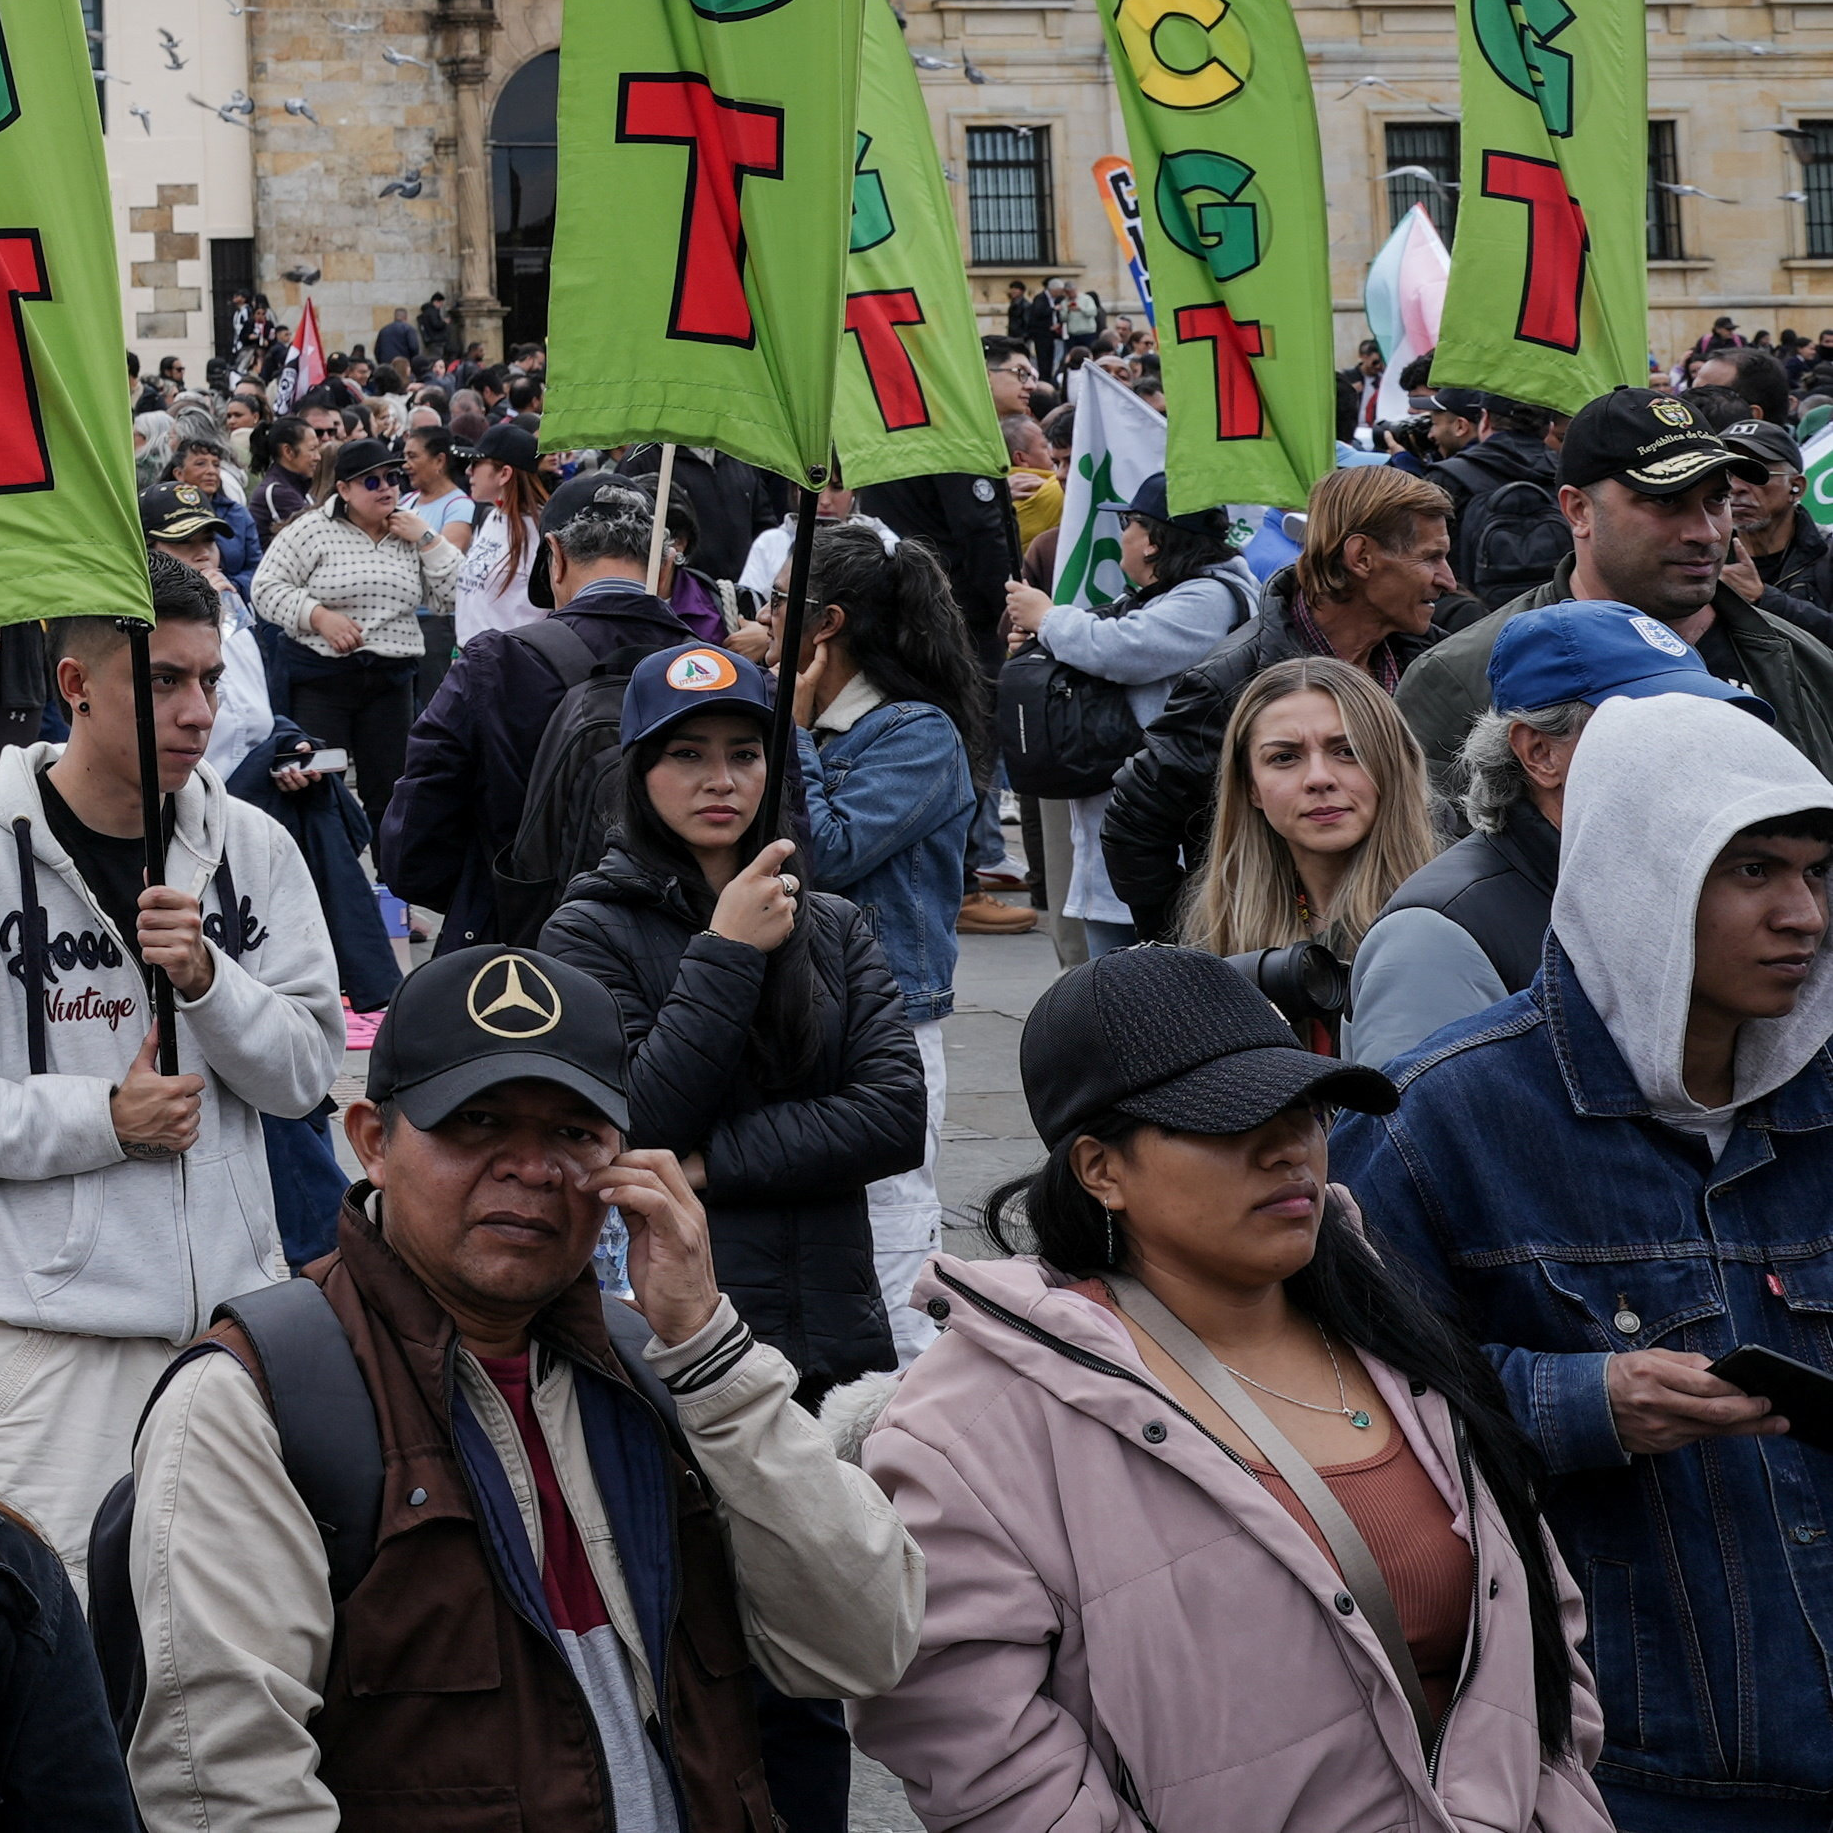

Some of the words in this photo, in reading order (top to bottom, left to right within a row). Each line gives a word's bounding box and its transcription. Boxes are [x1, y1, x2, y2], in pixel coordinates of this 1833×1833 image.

[1637, 433, 1686, 456] República
[1686, 430, 1697, 439] de
[43, 986, 136, 1032] Vintage
